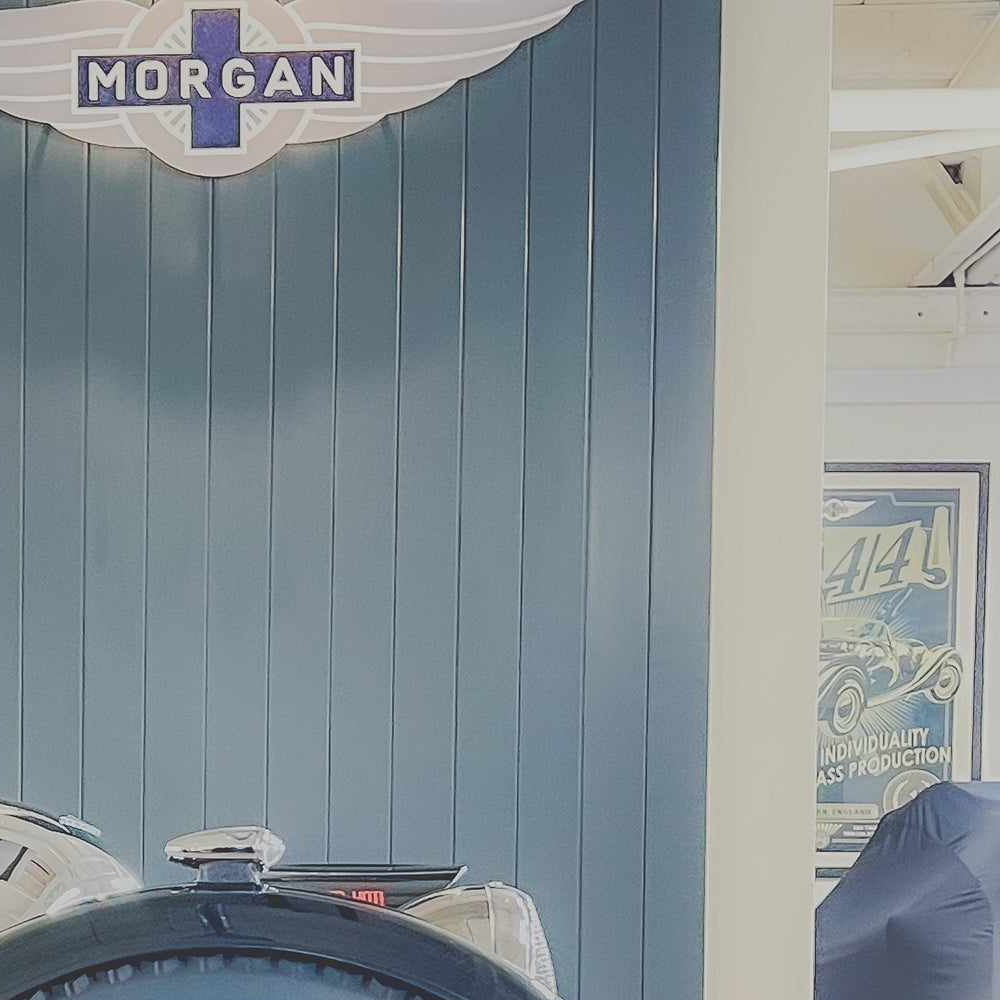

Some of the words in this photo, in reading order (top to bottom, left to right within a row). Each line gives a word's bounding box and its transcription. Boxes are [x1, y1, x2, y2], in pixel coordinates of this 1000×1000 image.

[88, 56, 346, 101] MORGAN
[821, 728, 930, 765] INDIVIDUALITY
[850, 747, 951, 777] PRODUCTION
